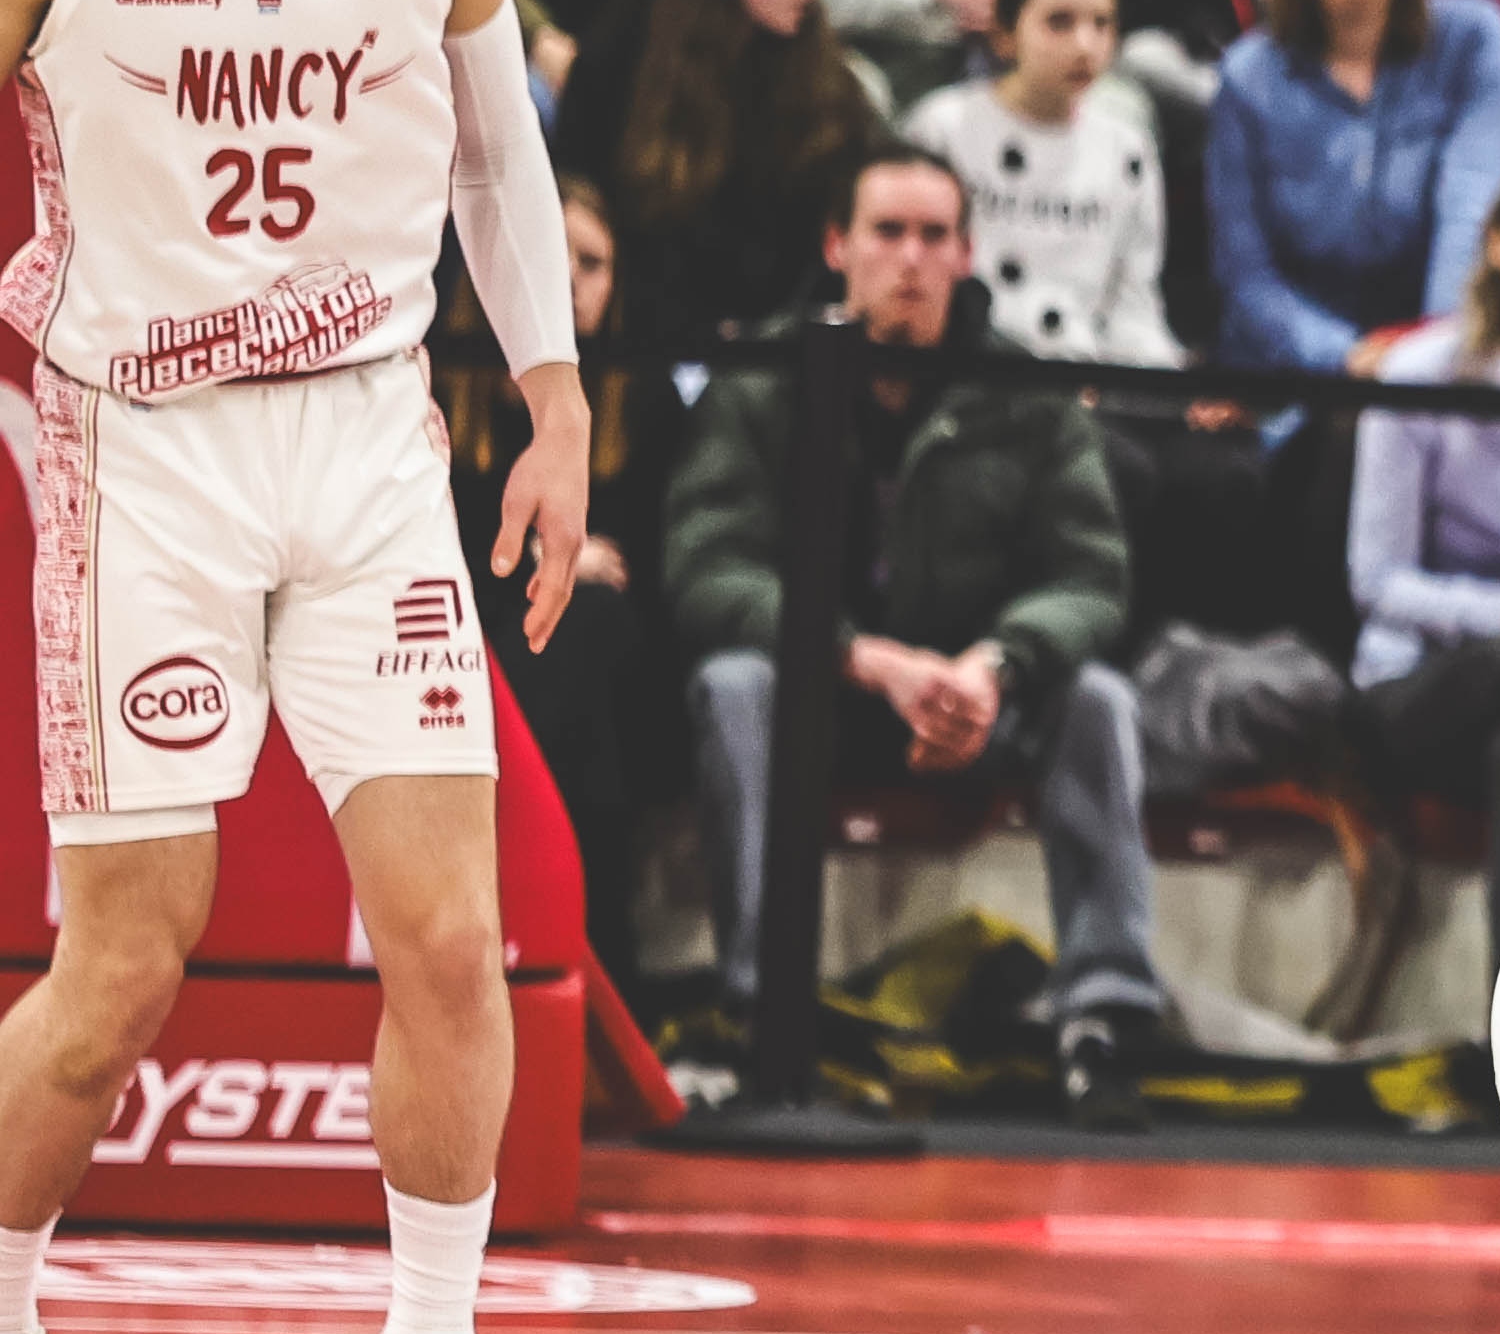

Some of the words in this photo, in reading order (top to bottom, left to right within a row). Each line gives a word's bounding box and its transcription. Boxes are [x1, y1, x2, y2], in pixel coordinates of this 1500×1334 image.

[177, 47, 364, 129] NANCY
[205, 146, 315, 243] 25
[129, 683, 223, 721] cora
[91, 1058, 373, 1165] YSTE
